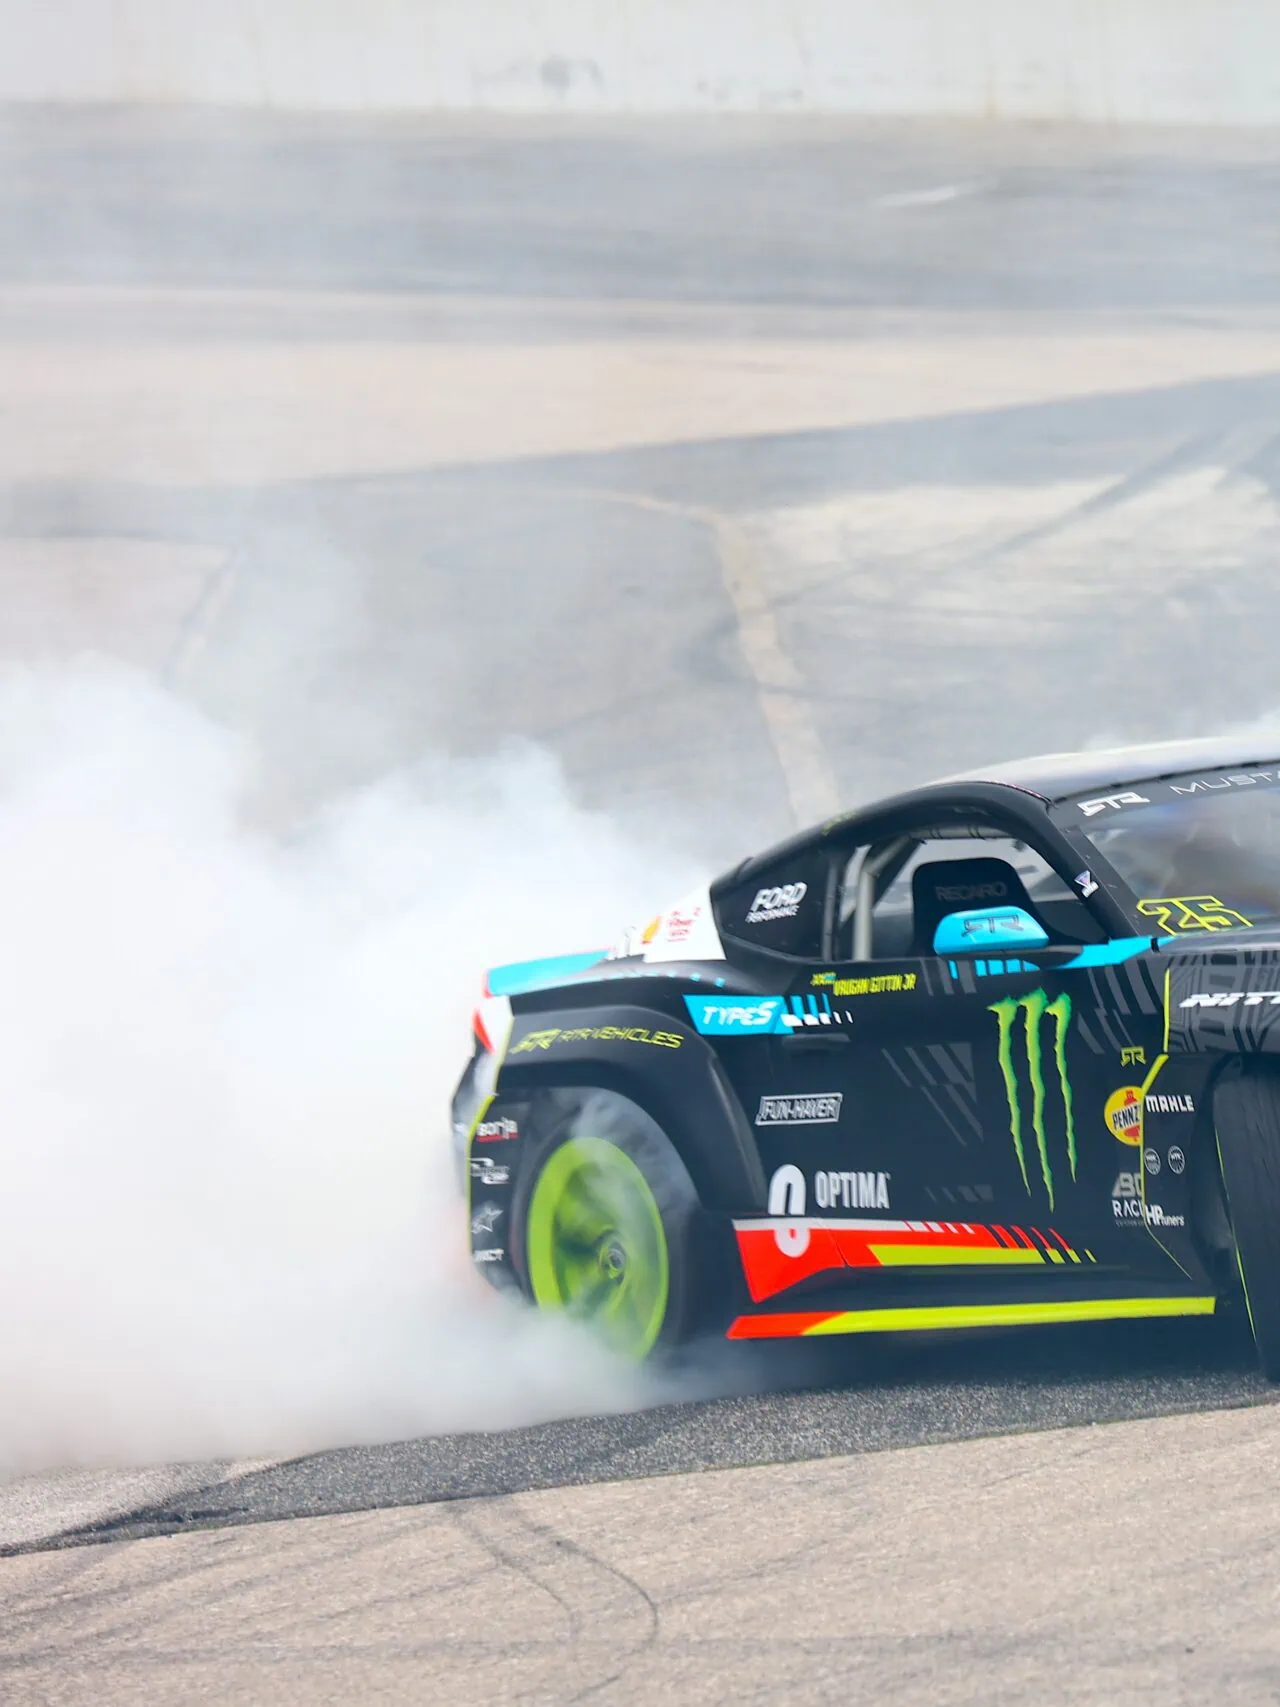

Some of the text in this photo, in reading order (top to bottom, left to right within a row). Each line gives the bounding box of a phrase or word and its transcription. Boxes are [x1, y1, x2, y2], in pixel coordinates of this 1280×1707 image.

[750, 881, 807, 912] FORD
[935, 881, 1007, 901] RECARO
[1136, 895, 1254, 937] 25
[903, 972, 917, 991] JR
[760, 1098, 838, 1120] FUN-HAVER
[1146, 1095, 1195, 1113] MAHLE
[814, 1170, 891, 1210] OPTIMA
